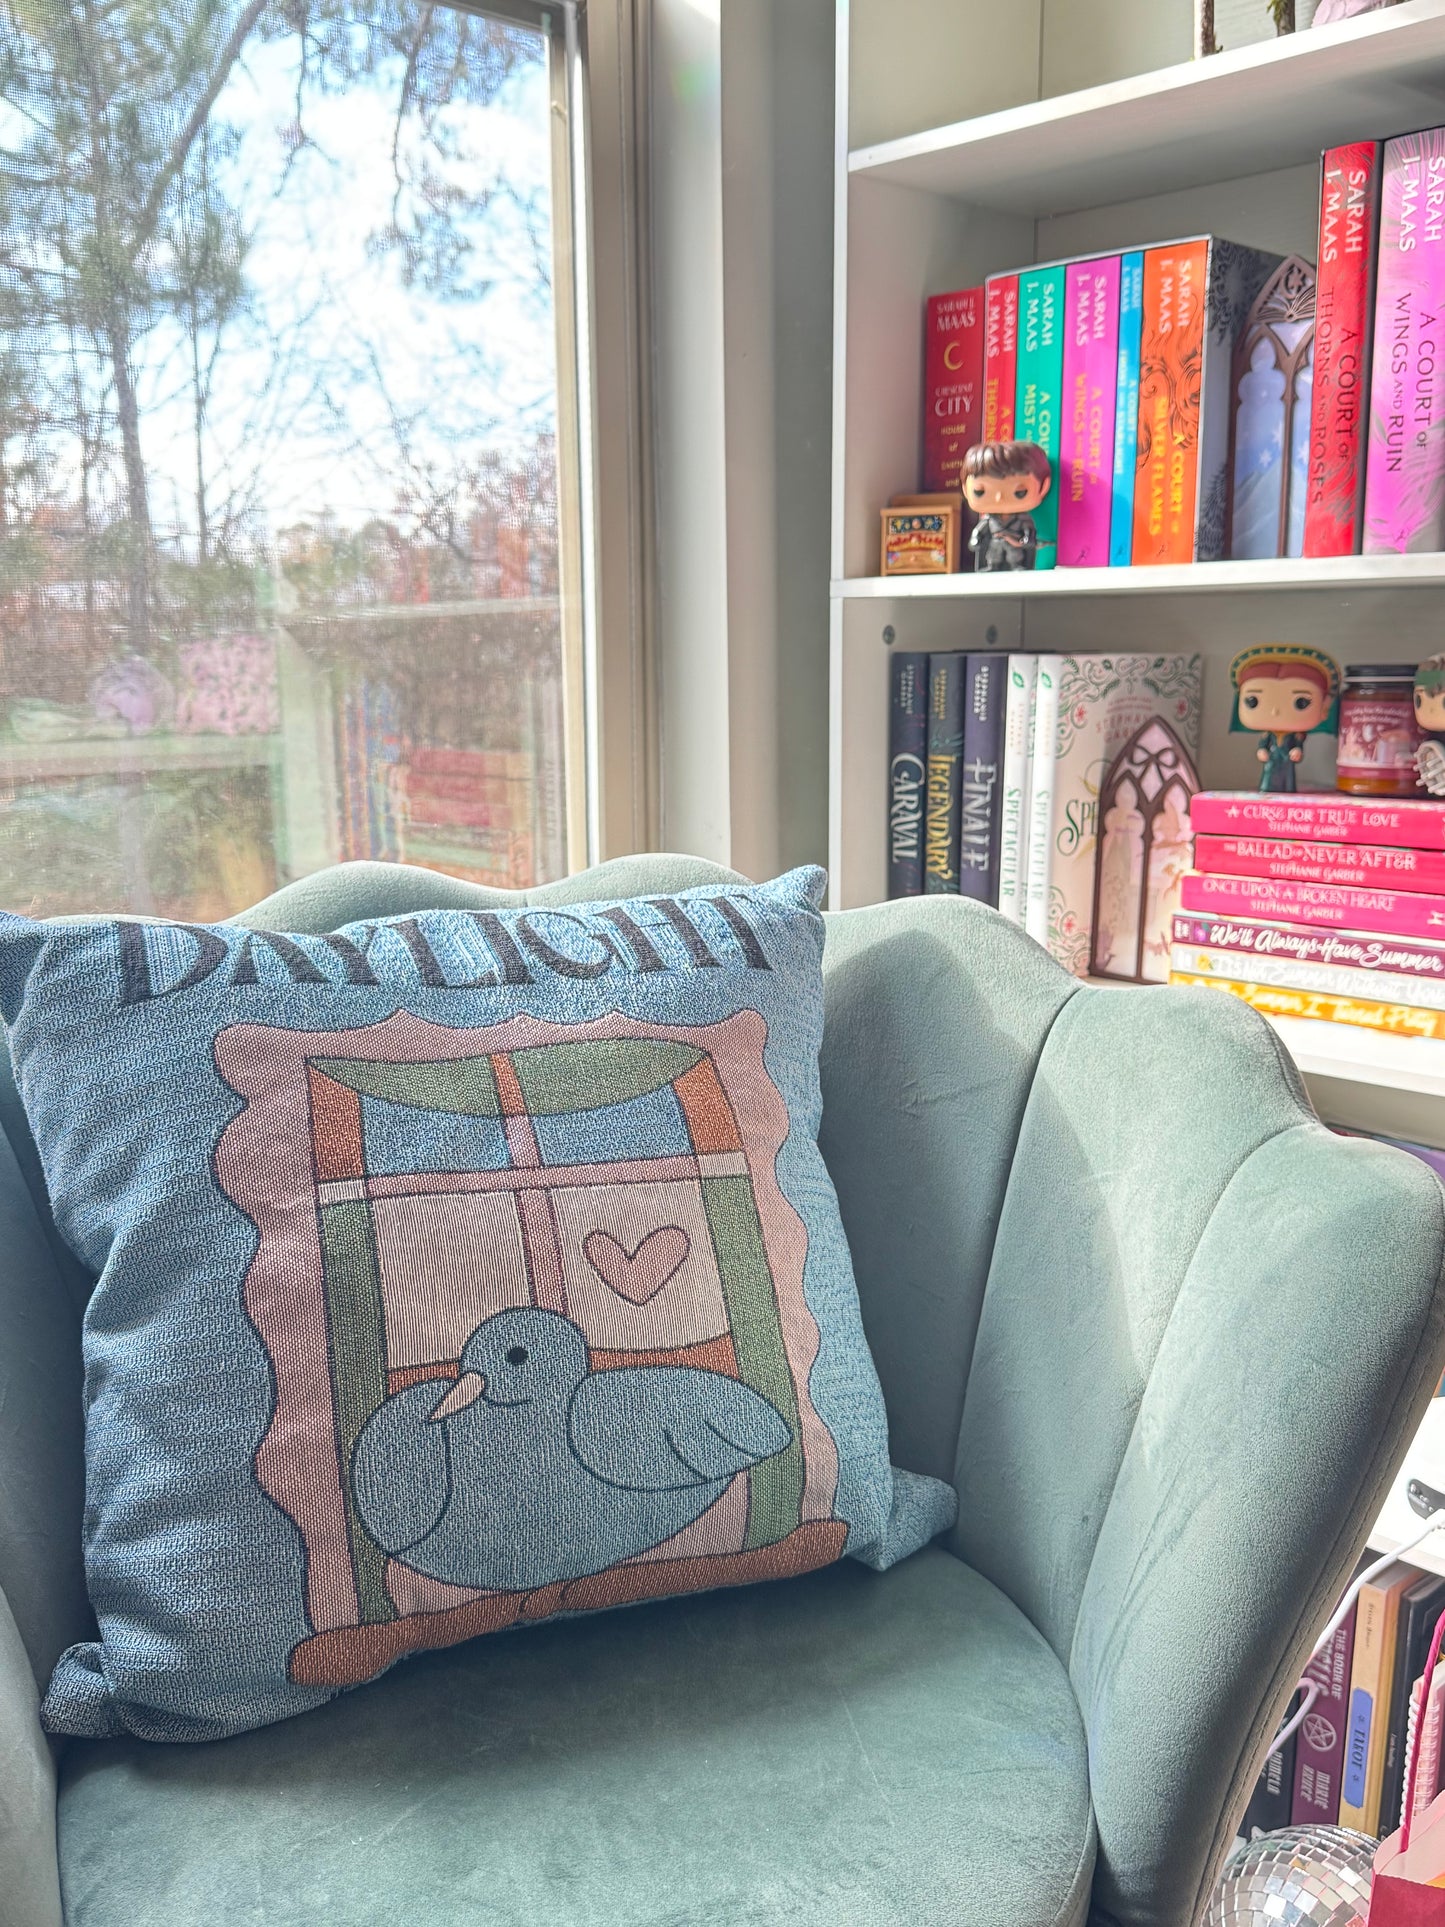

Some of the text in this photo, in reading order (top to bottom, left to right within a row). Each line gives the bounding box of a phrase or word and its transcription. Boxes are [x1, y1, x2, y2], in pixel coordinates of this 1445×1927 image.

[1323, 168, 1342, 264] J. MAAS
[1345, 170, 1367, 254] SARAH
[1400, 155, 1421, 252] J. MAAS
[1424, 156, 1445, 242] SARAH
[936, 312, 976, 332] MAAS
[988, 289, 1000, 357] J. MAAS
[1003, 291, 1016, 351] SARAH
[1026, 282, 1040, 352] J. MAAS
[1042, 283, 1055, 346] SARAH
[1076, 274, 1091, 346] J. MAAS
[1093, 275, 1107, 339] SARAH
[1159, 259, 1174, 334] J. MAAS
[1177, 260, 1192, 328] SARAH
[1316, 287, 1334, 389] THORNS
[935, 396, 974, 417] CITY
[1001, 407, 1012, 418] A
[1024, 384, 1037, 426] MIST
[1072, 373, 1087, 433] WINGS
[1090, 386, 1103, 400] A
[1335, 327, 1358, 459] A COURT OF
[1386, 292, 1412, 473] WINGS AND RUIN
[1414, 312, 1437, 448] A COURT OF
[1038, 391, 1052, 458] A COU
[1089, 407, 1102, 469] COURT
[1173, 432, 1187, 446] A
[1071, 458, 1085, 502] RUIN
[1150, 463, 1166, 537] FLAMES
[1170, 450, 1186, 514] COURT
[891, 752, 926, 864] CARAVAL
[925, 754, 957, 880] LEGENDARY
[961, 756, 997, 872] FINALE
[1243, 804, 1286, 822] CURSE
[1287, 807, 1313, 823] FOR
[1317, 808, 1357, 826] TRUE
[1362, 812, 1400, 828] LOVE
[1003, 787, 1022, 897] SPECTACULAR
[1237, 841, 1293, 860] BALLAD
[1303, 845, 1361, 866] NEVER
[1360, 850, 1417, 871] AFTER
[1269, 862, 1322, 879] STEPHANIE
[1202, 879, 1397, 912] ONCE UPON A BROKEN HEART
[1250, 900, 1301, 916] STEPHANIE
[117, 893, 773, 1001] DAYLIGHT
[1210, 922, 1254, 946] We'll
[1254, 929, 1318, 961] Always
[1316, 937, 1363, 963] Have
[1359, 943, 1444, 972] Summer
[1331, 1628, 1347, 1701] THE BOOK OF
[1352, 1728, 1366, 1771] TAROT
